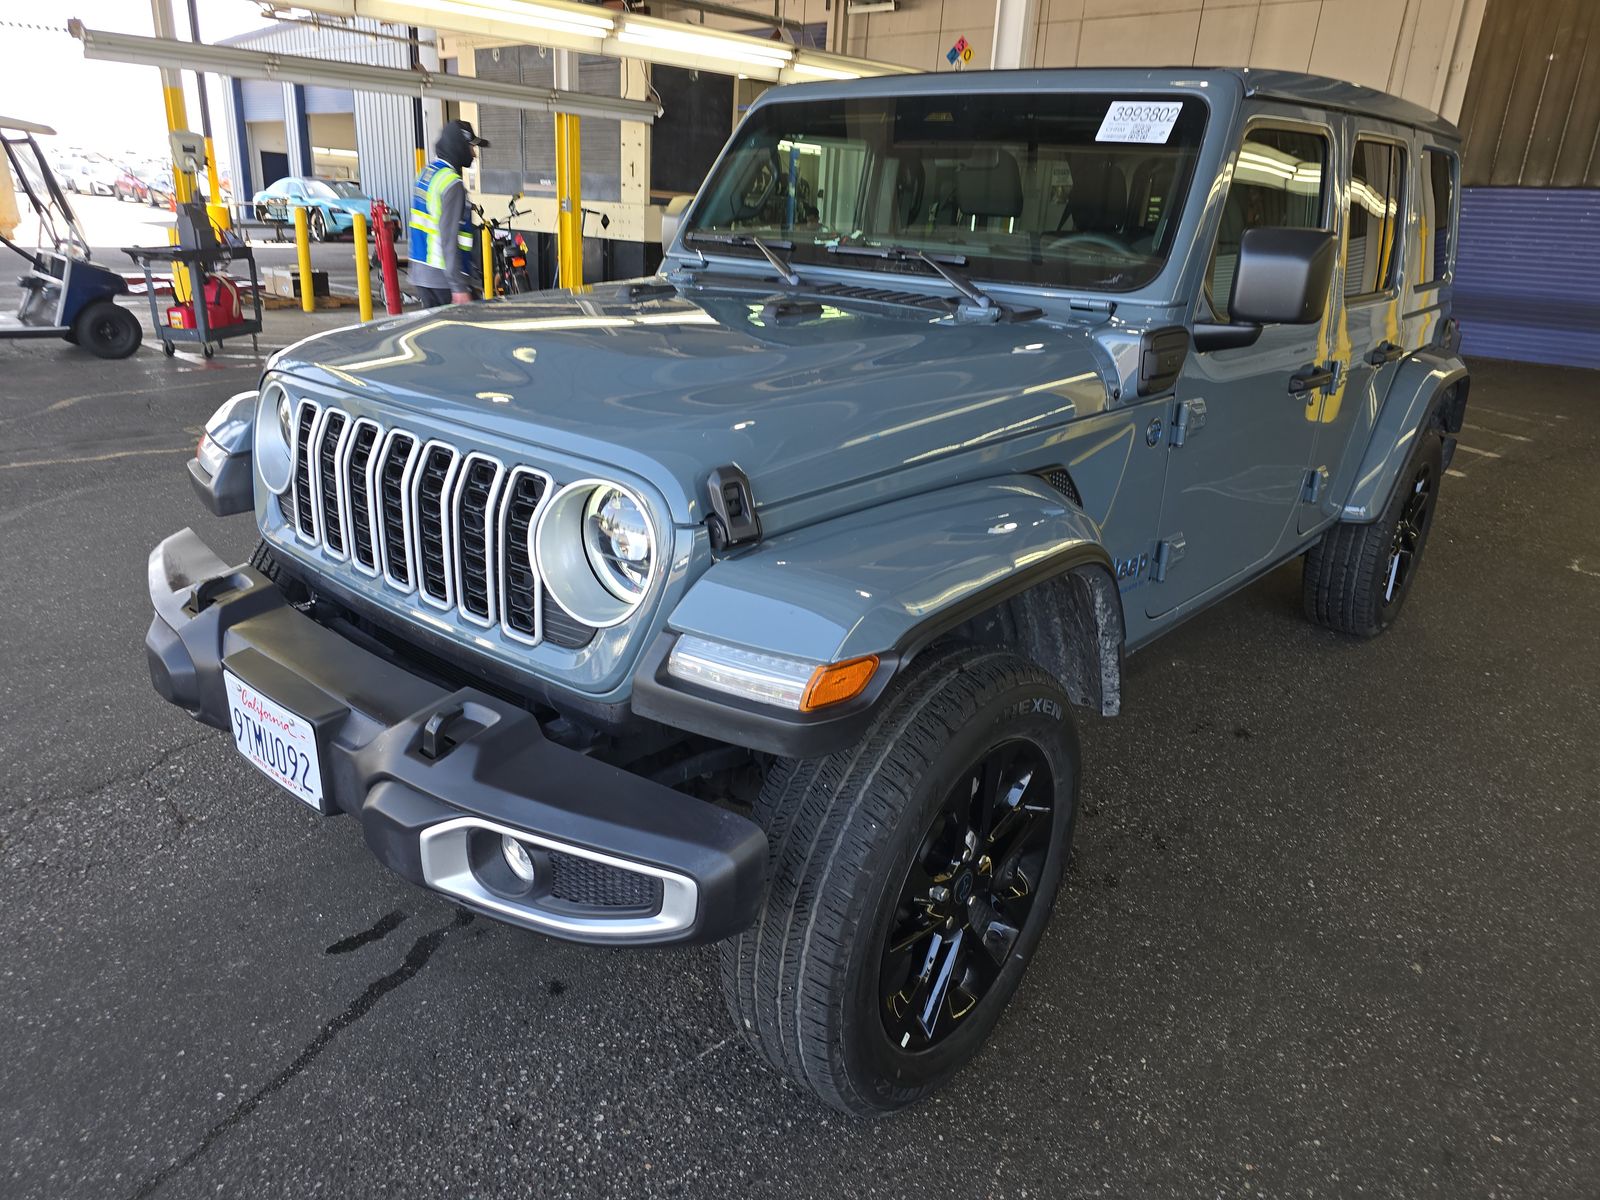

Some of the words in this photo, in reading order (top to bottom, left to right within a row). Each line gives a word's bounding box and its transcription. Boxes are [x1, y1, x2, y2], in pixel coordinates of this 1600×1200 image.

[957, 39, 965, 52] 3
[1113, 106, 1180, 122] 3993802
[241, 689, 298, 739] California
[234, 707, 314, 794] 9TMU092
